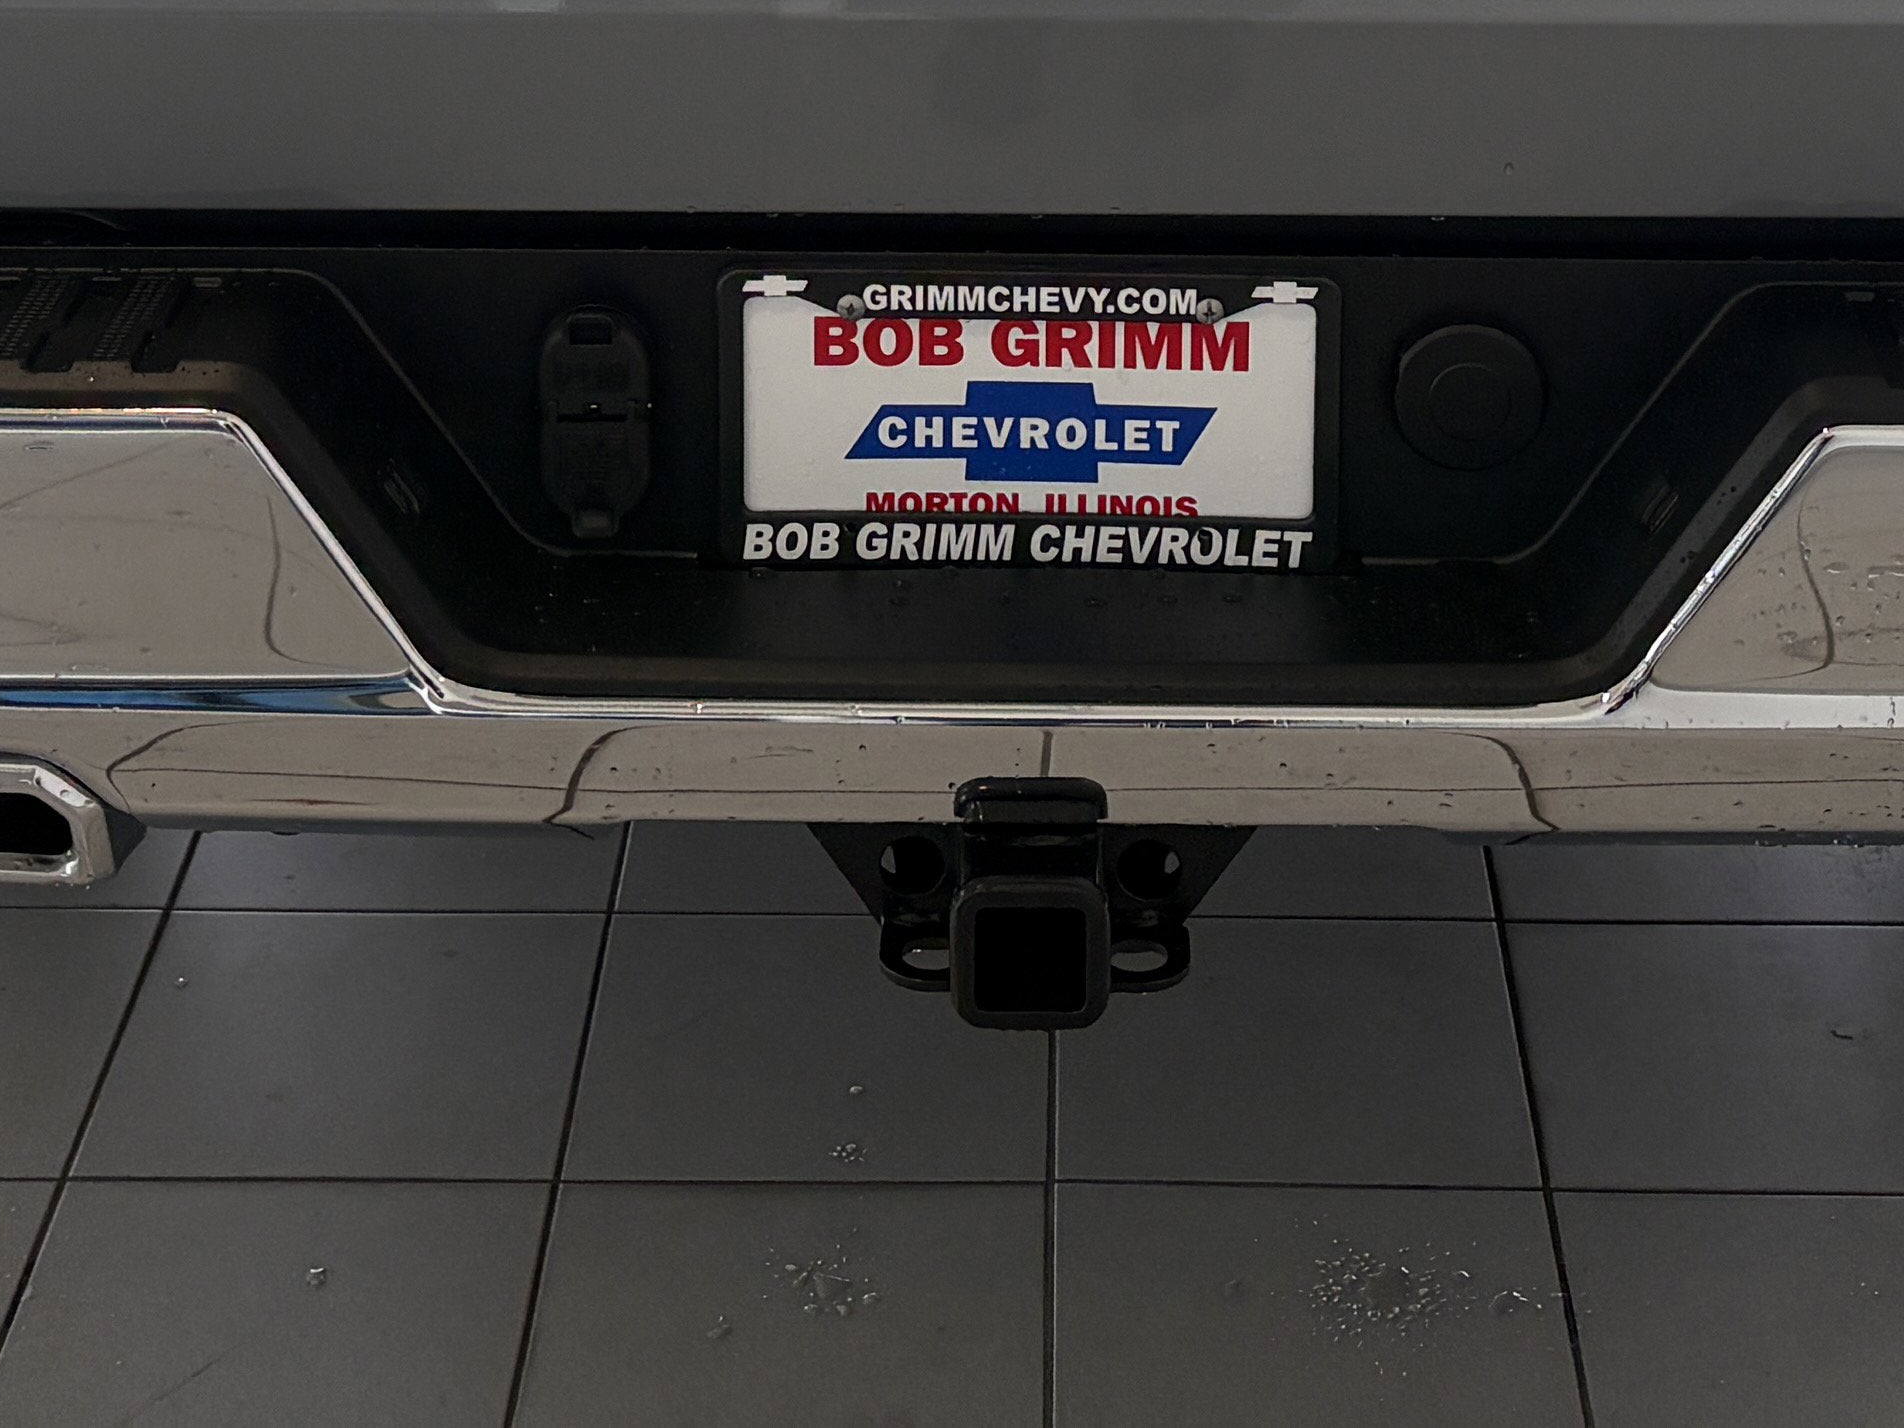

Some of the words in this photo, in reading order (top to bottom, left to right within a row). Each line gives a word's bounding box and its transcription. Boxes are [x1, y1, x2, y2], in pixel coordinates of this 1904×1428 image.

[862, 284, 1197, 315] GRIMMCHEVY.COM
[813, 316, 965, 368] BOB
[990, 320, 1251, 372] GRIMM
[876, 415, 1181, 453] CHEVROLET
[1044, 493, 1199, 517] ILLINOIS
[743, 523, 840, 561] BOB
[855, 524, 1015, 561] GRIMM
[1029, 525, 1313, 569] CHEVROLET
